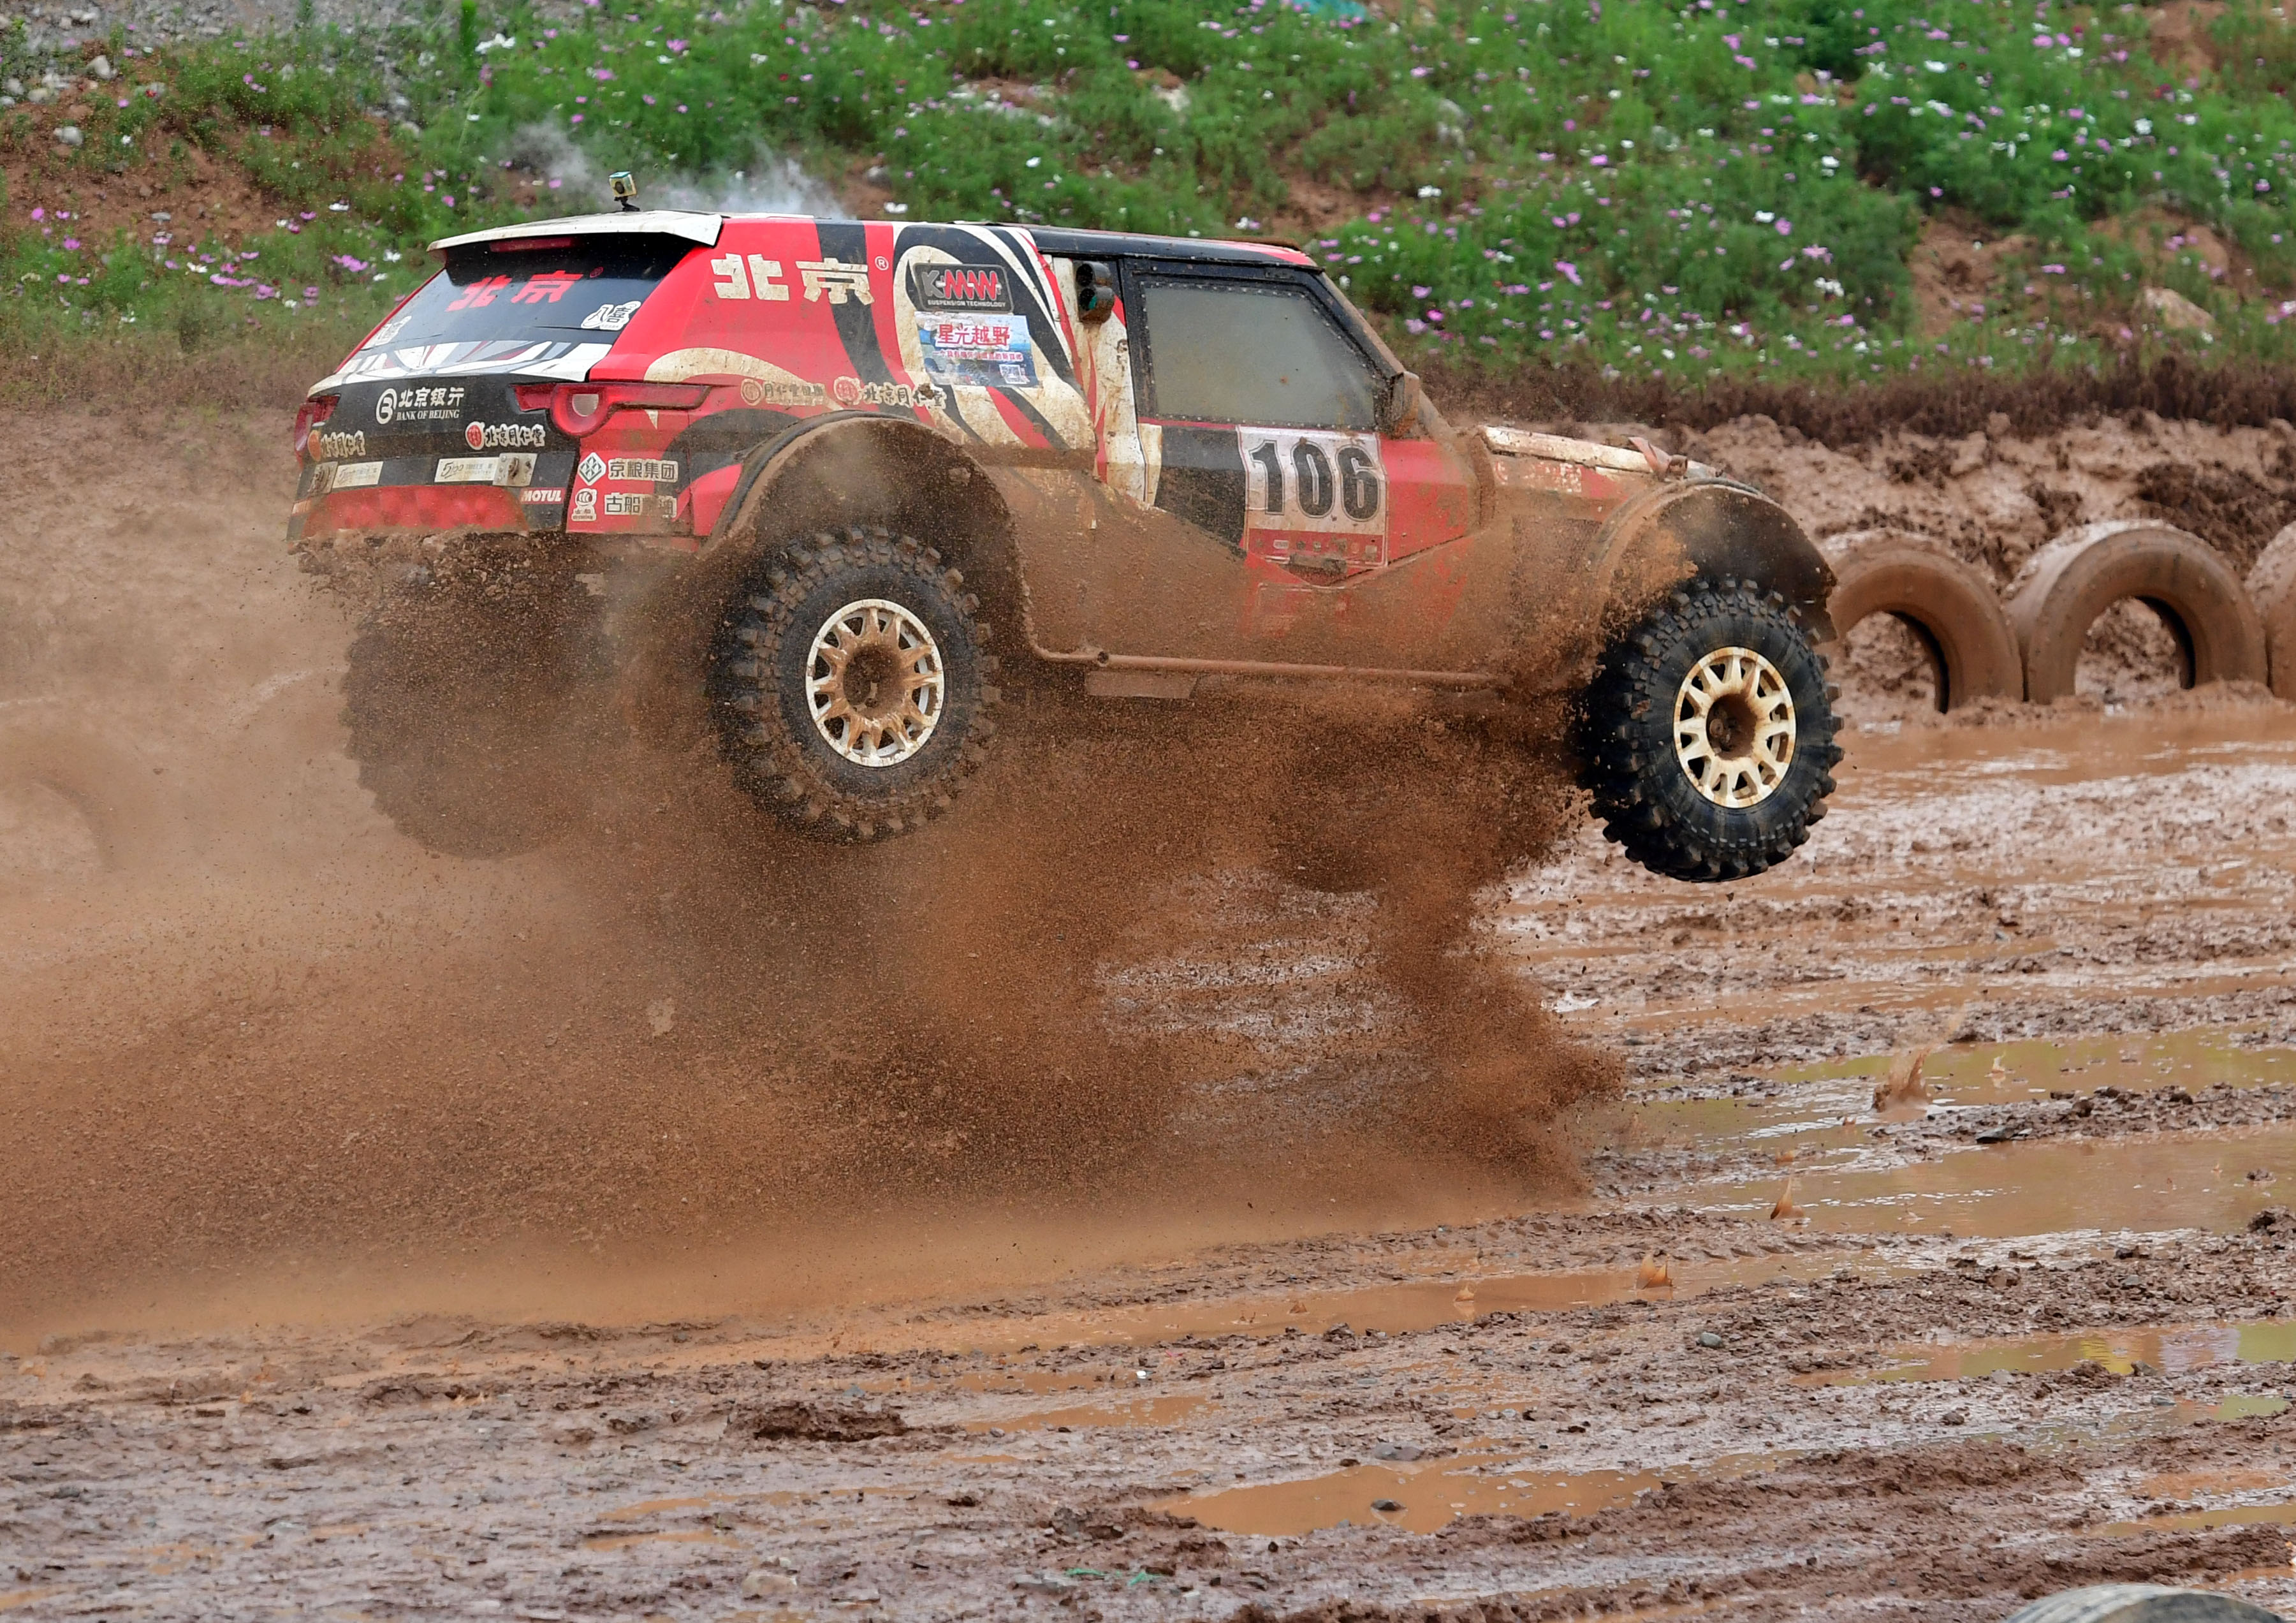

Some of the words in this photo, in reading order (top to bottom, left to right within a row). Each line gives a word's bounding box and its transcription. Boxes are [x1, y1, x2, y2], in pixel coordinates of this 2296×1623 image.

[710, 253, 875, 305] 北京
[445, 270, 584, 312] 北京
[937, 323, 1010, 346] 星光越野
[398, 387, 464, 408] 北京银行
[396, 411, 415, 422] BANK
[417, 410, 427, 419] OF
[428, 409, 460, 419] BEIJING
[610, 462, 675, 480] 京粮集团
[1248, 440, 1381, 522] 106
[521, 490, 561, 501] MOTUL
